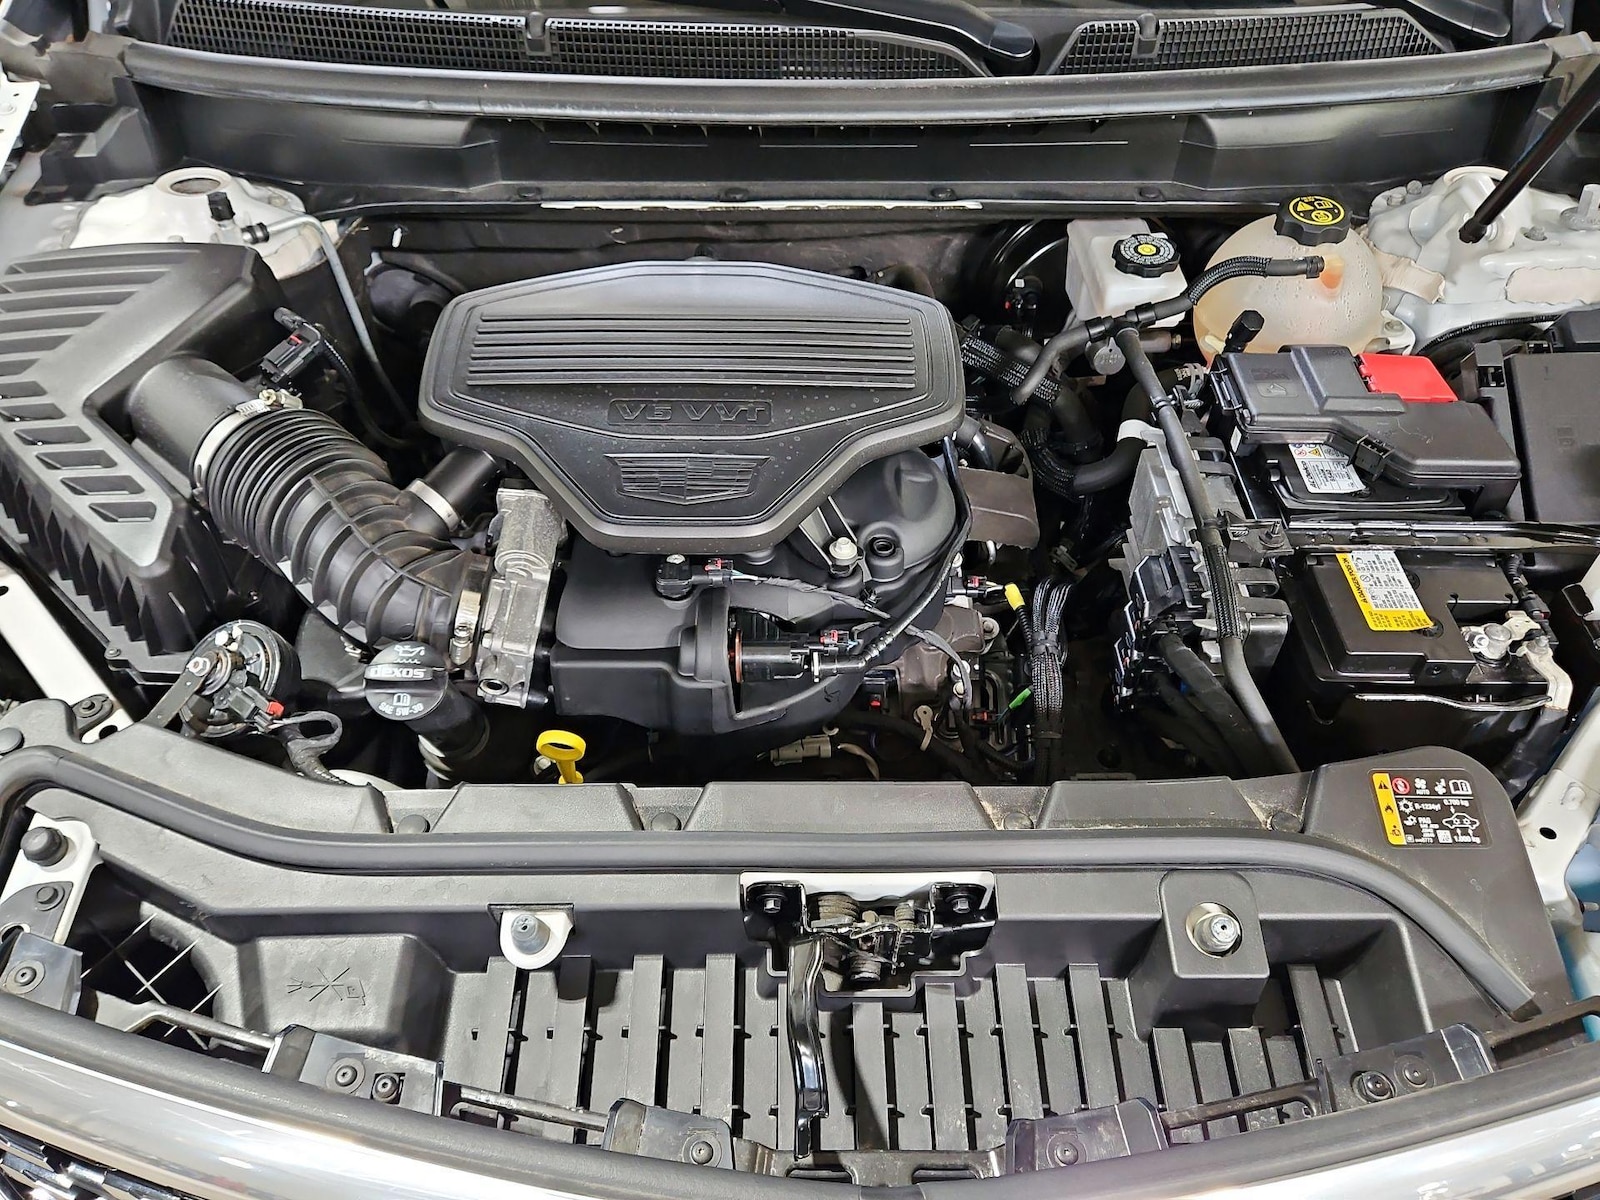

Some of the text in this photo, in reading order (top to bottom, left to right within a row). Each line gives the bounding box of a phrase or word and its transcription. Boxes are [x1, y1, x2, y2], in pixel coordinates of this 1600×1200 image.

[615, 403, 765, 421] V6 VVT
[369, 665, 427, 679] dexos
[378, 702, 424, 716] SAE 5W-30
